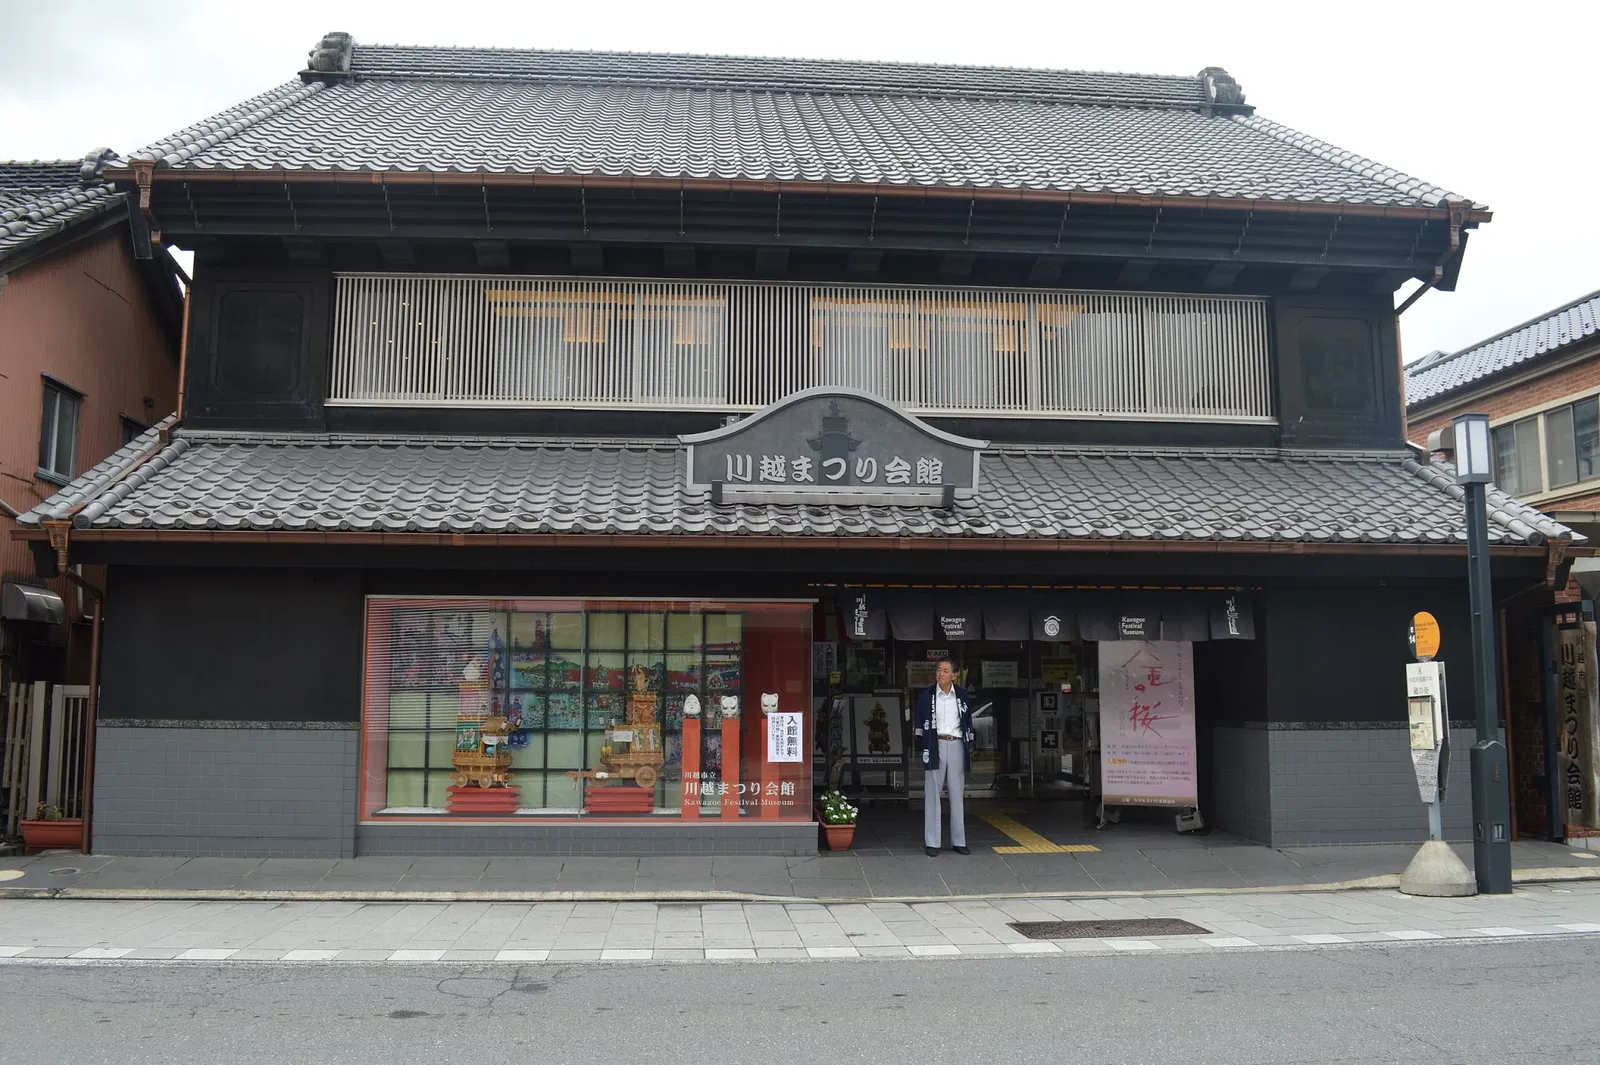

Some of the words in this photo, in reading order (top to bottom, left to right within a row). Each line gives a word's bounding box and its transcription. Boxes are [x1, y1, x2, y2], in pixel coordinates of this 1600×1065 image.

[725, 453, 944, 485] 川越まつり会館
[1409, 635, 1416, 643] 14
[1576, 634, 1586, 698] 川越市立
[787, 715, 798, 757] 入館無料
[1560, 643, 1582, 810] 川越まつり会館
[684, 771, 716, 780] 川越市立
[684, 781, 796, 797] 川越まつり会館
[684, 799, 721, 807] Kawagoe
